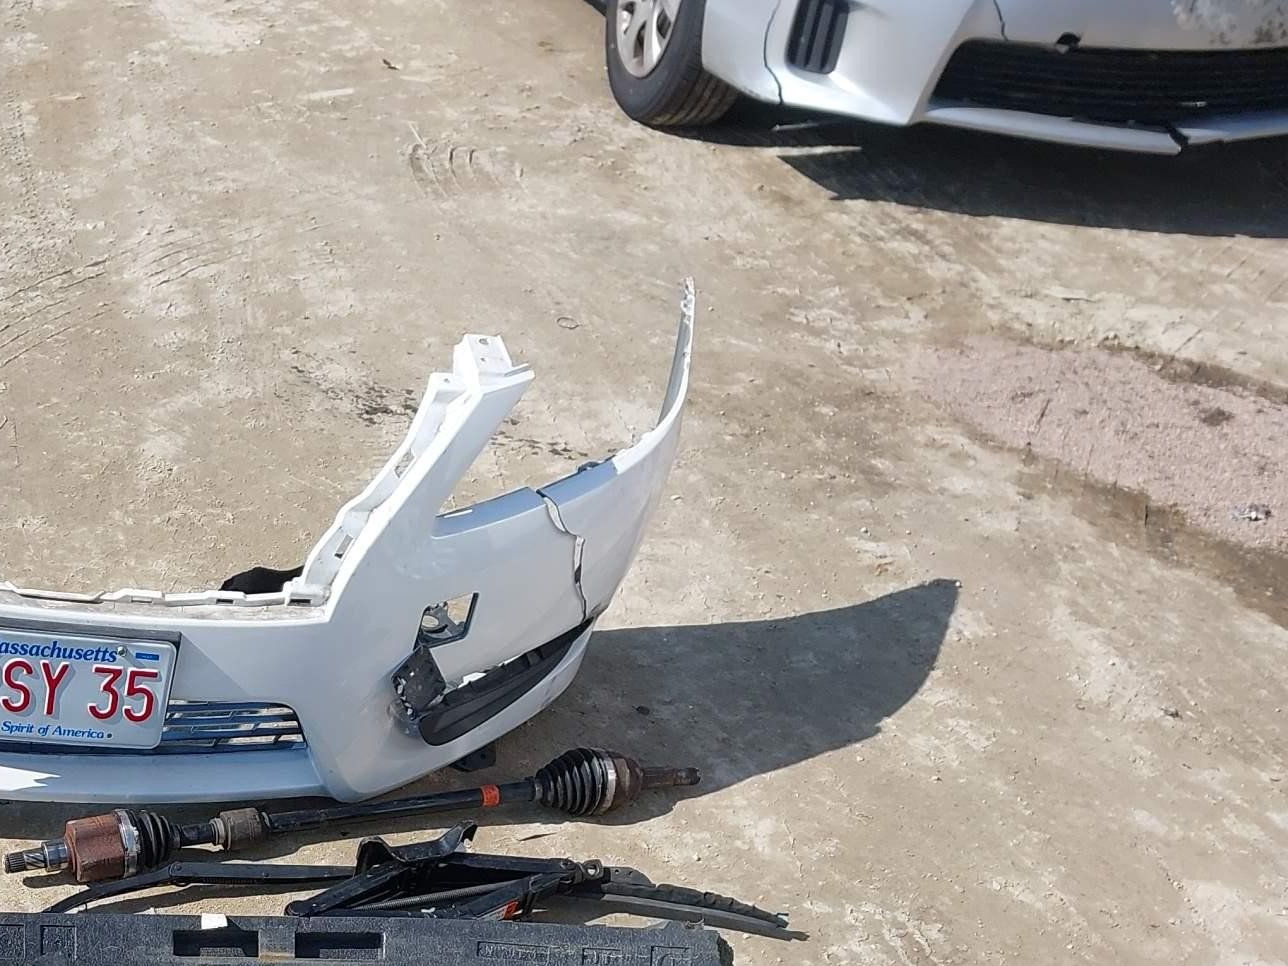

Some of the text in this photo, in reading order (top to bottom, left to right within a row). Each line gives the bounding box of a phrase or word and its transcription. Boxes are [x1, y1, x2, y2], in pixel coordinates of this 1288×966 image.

[88, 664, 160, 722] 35
[0, 720, 34, 735] Spirit
[37, 724, 51, 737] of
[52, 725, 105, 739] America
